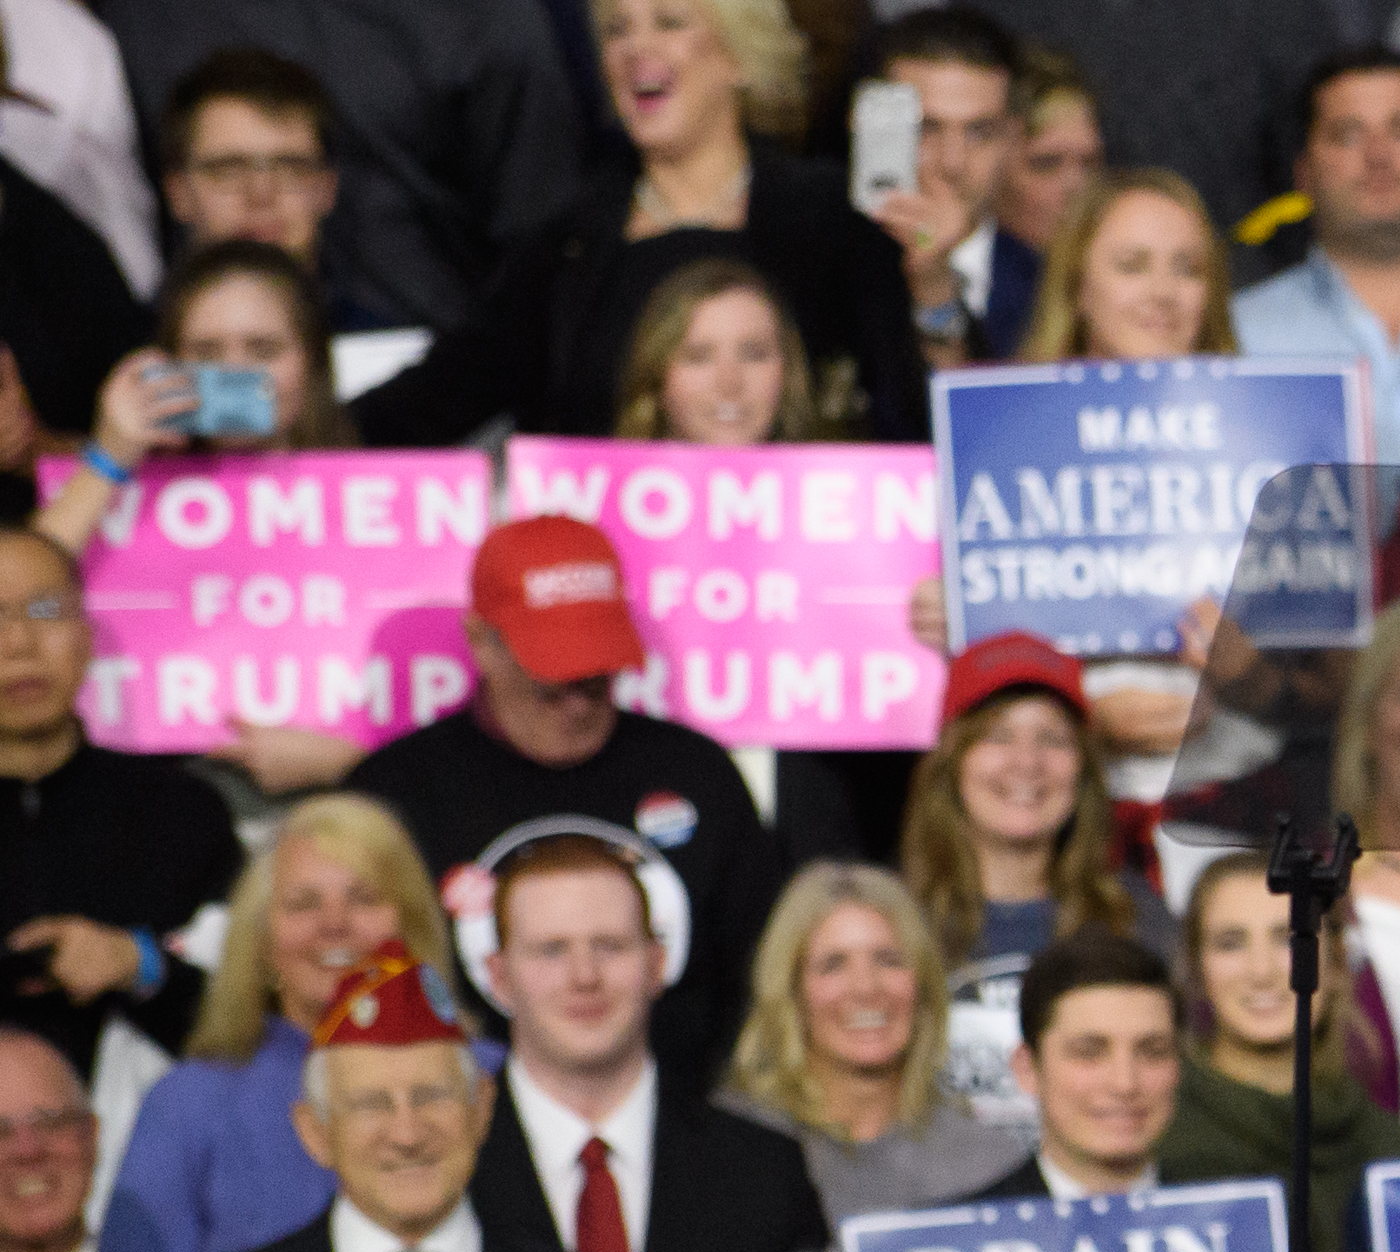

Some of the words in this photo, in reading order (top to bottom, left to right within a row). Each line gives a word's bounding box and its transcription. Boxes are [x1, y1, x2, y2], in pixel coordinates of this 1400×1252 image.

[1077, 403, 1220, 452] MAKE
[516, 465, 939, 543] WOMEN
[959, 462, 1351, 541] AMERICA
[190, 572, 347, 628] FOR
[649, 568, 800, 624] FOR
[962, 543, 1180, 603] STRONG
[1189, 541, 1355, 596] AGAIN
[88, 654, 470, 728] TRUMP
[612, 649, 920, 723] RUMP
